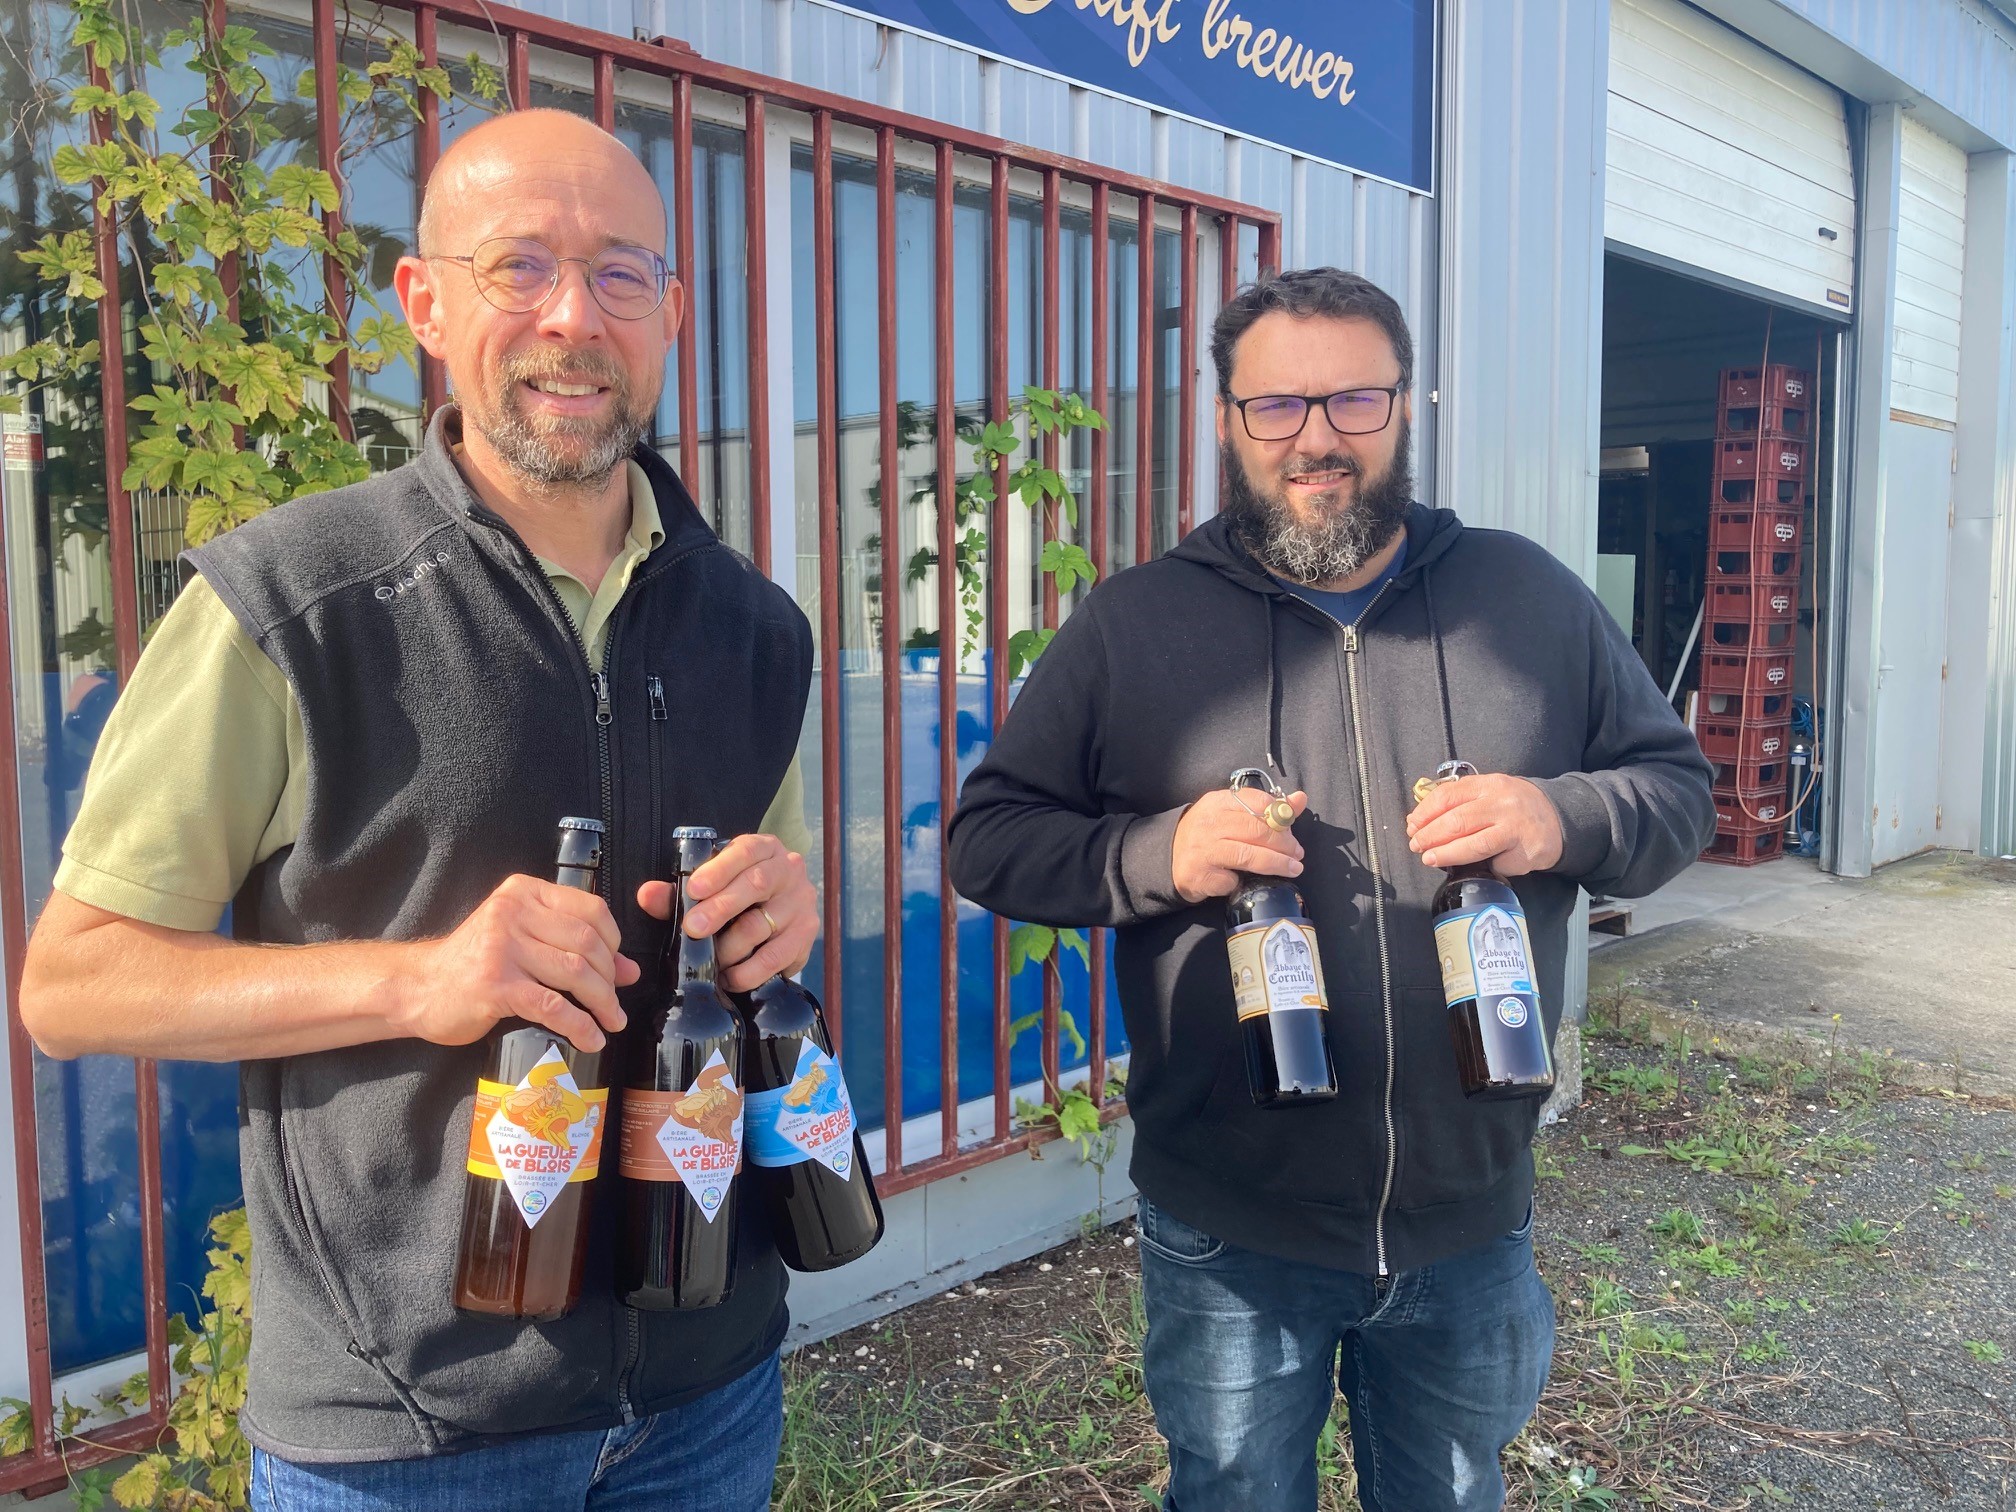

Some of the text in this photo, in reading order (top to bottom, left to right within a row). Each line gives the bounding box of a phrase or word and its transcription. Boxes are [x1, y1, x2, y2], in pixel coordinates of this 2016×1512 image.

[1201, 0, 1356, 106] brewer
[1483, 949, 1521, 958] Abbaye de
[1274, 963, 1311, 973] Abbaye de
[1478, 956, 1525, 970] Cornilly
[1268, 971, 1315, 985] Cornilly
[782, 1118, 812, 1132] ARTISANALE
[795, 1103, 850, 1142] LA GUEULE
[491, 1131, 522, 1139] ARTISANALE
[807, 1116, 851, 1149] DE BLOIS
[498, 1143, 578, 1159] LA GUEULE
[673, 1140, 738, 1158] LA GUEULE
[505, 1158, 521, 1169] DE
[524, 1159, 571, 1173] BLOIS
[682, 1155, 735, 1171] DE BLOIS
